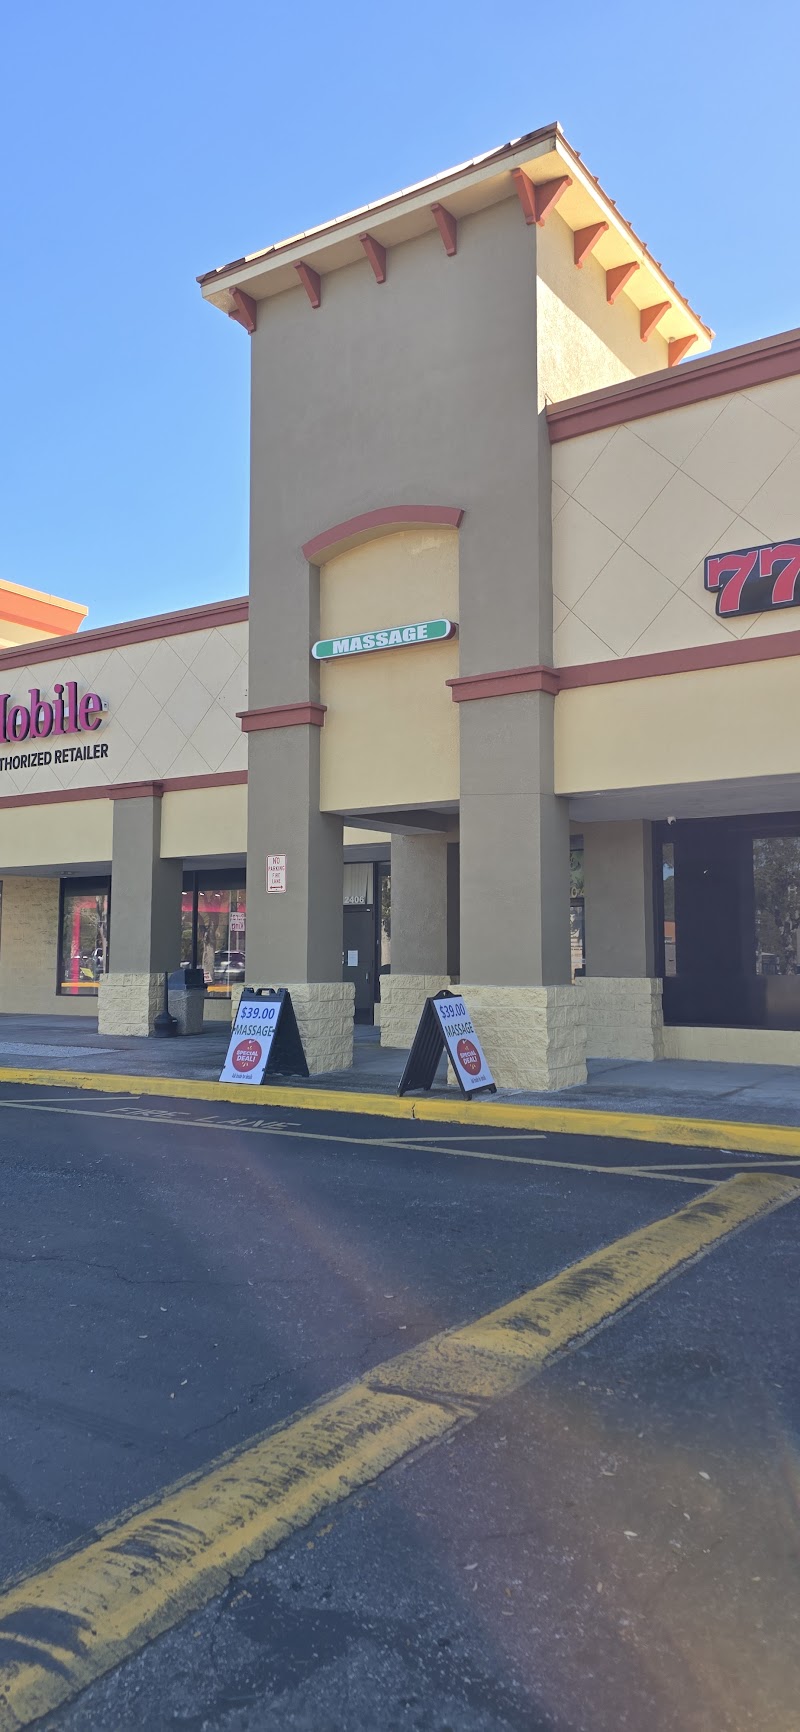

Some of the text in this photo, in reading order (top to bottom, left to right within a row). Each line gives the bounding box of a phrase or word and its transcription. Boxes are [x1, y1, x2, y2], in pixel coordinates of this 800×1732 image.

[332, 624, 428, 655] MASSAGE
[54, 743, 109, 764] RETAILER
[344, 895, 365, 904] 2406
[241, 1007, 275, 1019] $39.00
[439, 1003, 466, 1019] $39.00
[235, 1025, 274, 1036] MASSAGE
[444, 1022, 474, 1038] MASSAGE
[105, 1107, 302, 1130] FIRE LANE
